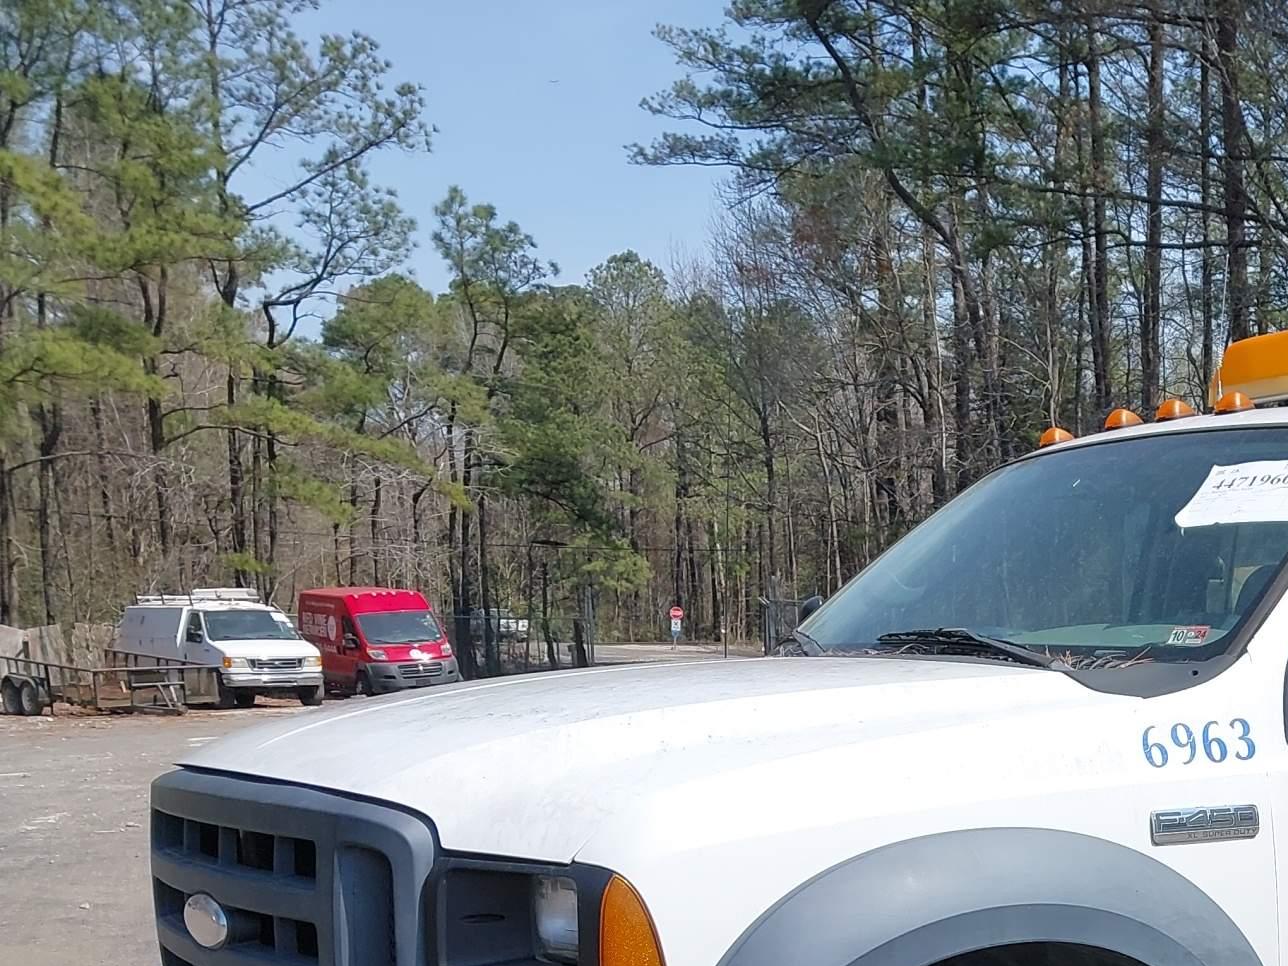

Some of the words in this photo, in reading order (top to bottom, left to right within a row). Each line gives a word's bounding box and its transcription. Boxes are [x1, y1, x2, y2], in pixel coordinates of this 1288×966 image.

[1172, 630, 1185, 642] 10
[1142, 717, 1256, 769] 6963
[1153, 804, 1258, 834] F-450
[1233, 826, 1258, 836] DUTY
